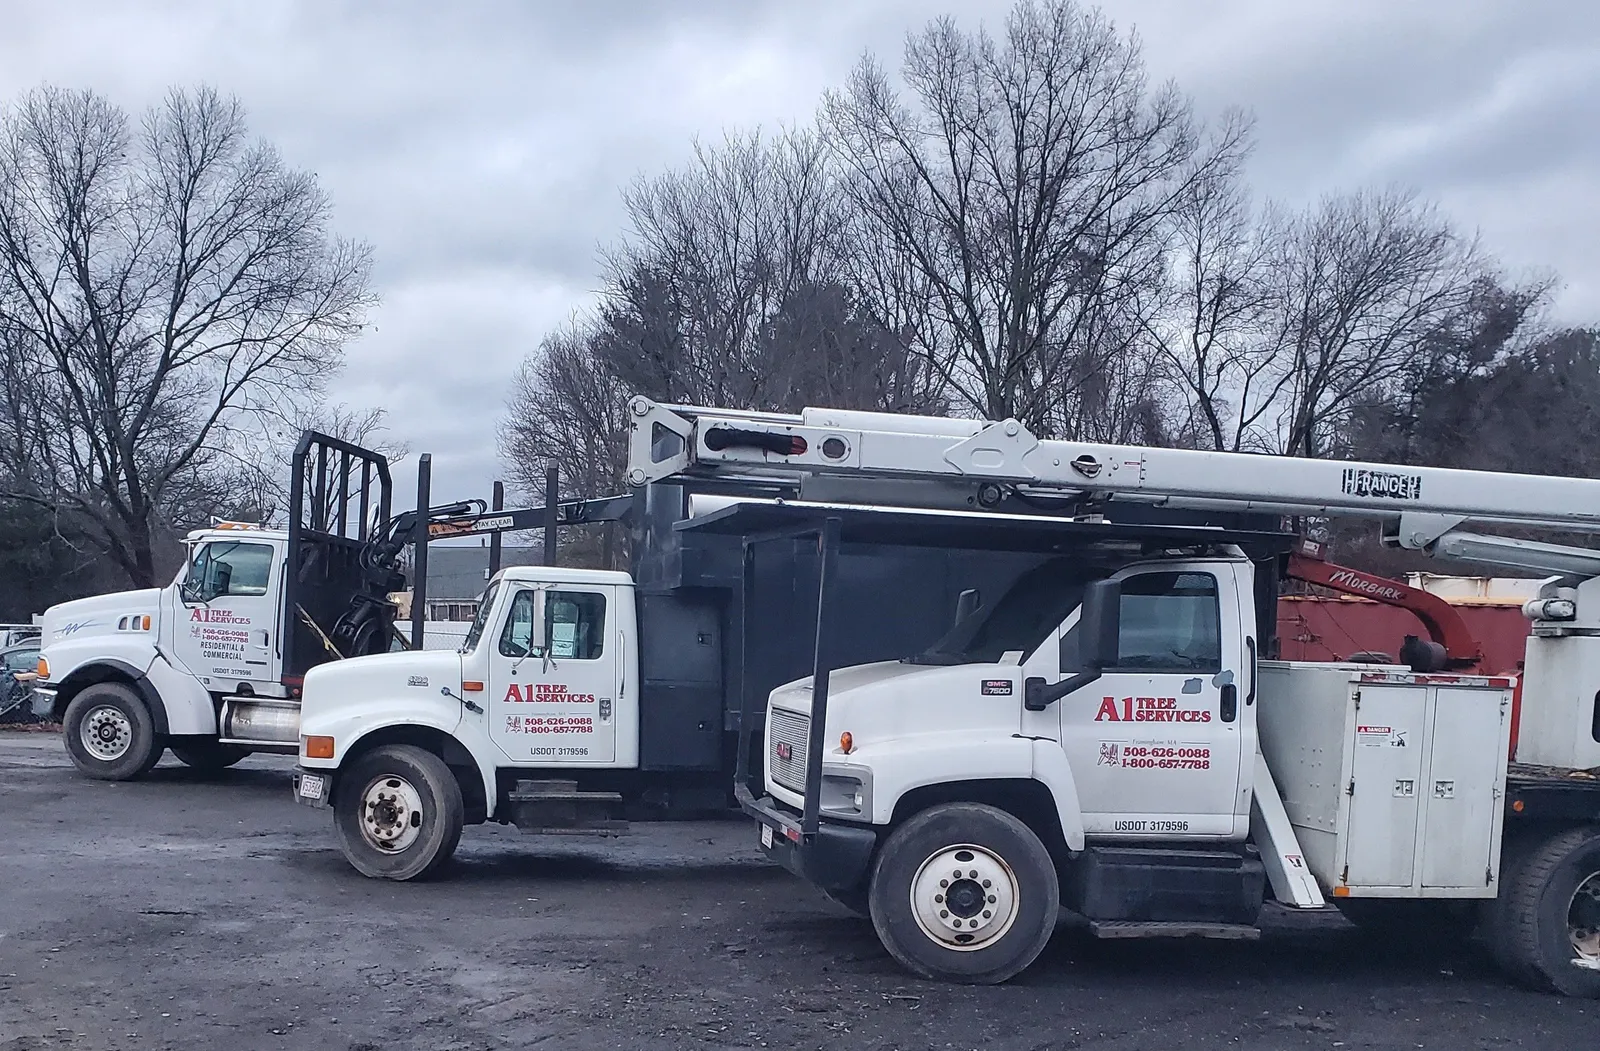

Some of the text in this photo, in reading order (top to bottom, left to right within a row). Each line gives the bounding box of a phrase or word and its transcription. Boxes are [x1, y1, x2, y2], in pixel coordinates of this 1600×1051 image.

[491, 518, 512, 528] CLEAR
[1329, 570, 1401, 600] MORBARK
[190, 608, 210, 622] A1
[210, 616, 250, 624] SERVICES
[202, 628, 248, 637] 508-626-0088
[200, 641, 238, 652] RESIDENTIAL
[203, 650, 242, 660] COMMERCIAL
[503, 684, 568, 702] A1 TREE
[536, 694, 594, 702] SERVICES
[1094, 696, 1177, 722] A1 TREE
[1135, 710, 1212, 722] SERVICES
[524, 718, 592, 726] 508-626-0088
[524, 726, 593, 734] 1-800-657-7788
[530, 747, 588, 756] USDOT 3179596
[1123, 746, 1210, 758] 508-626-0088
[1122, 758, 1210, 770] 1-800-657-7788
[1114, 820, 1188, 831] USDOT 3179596
